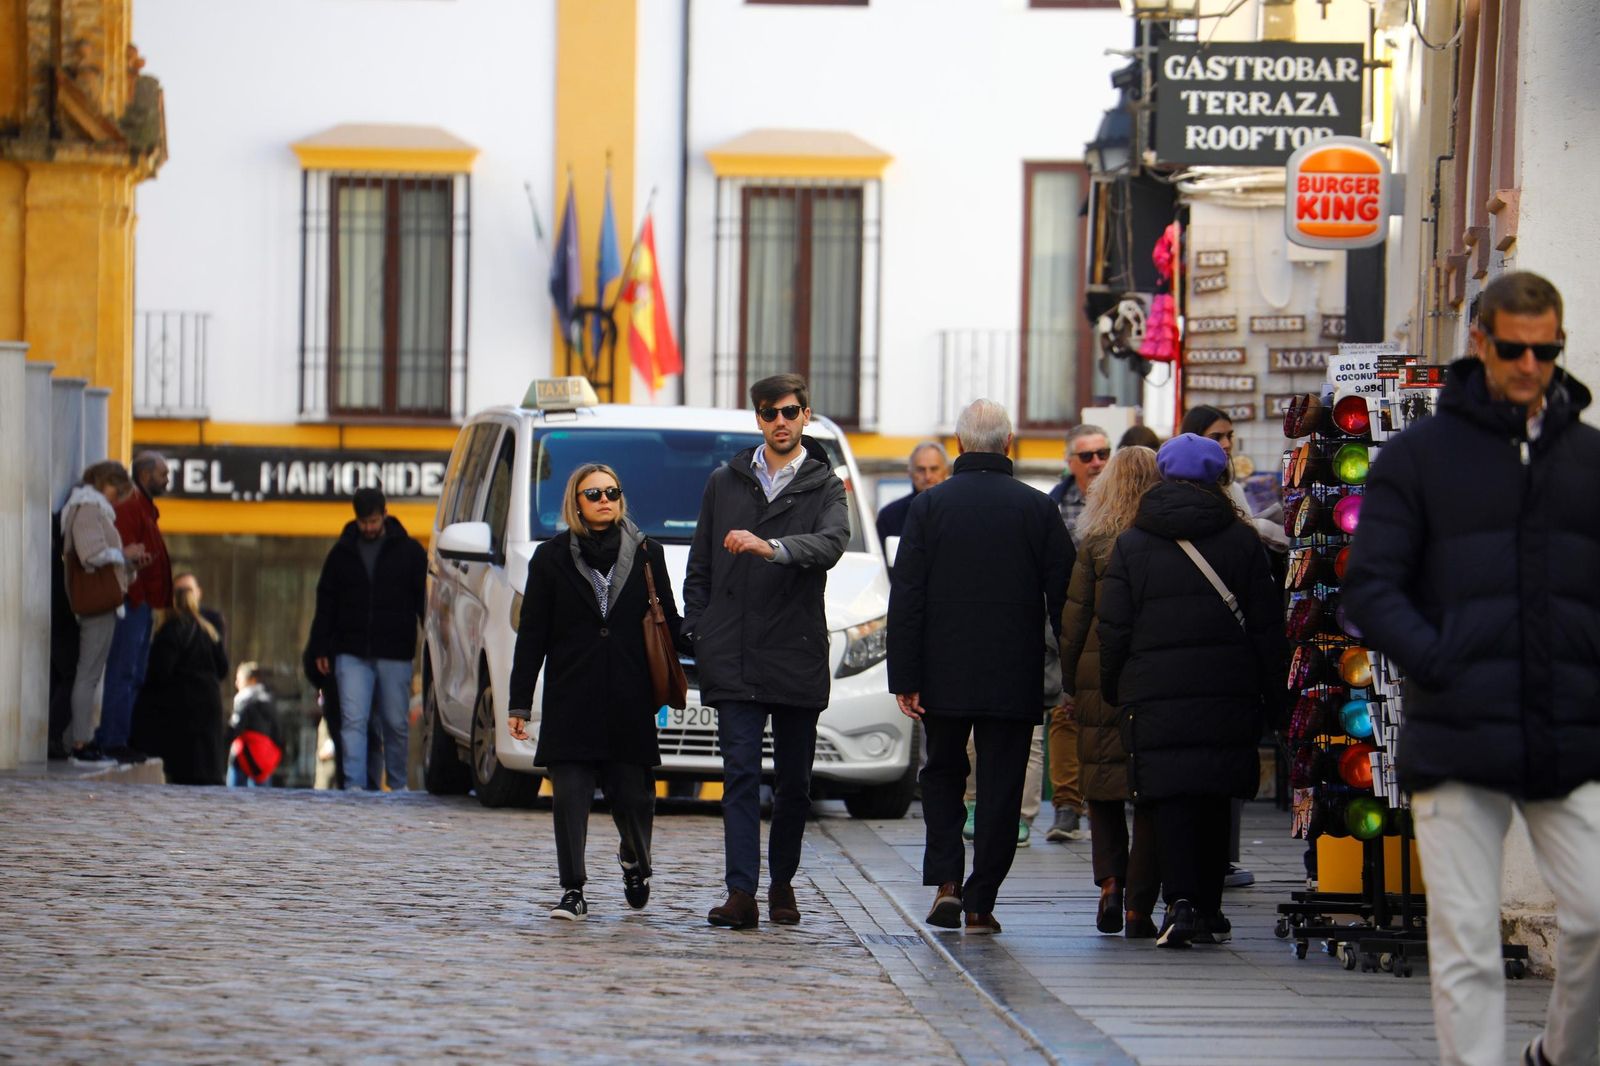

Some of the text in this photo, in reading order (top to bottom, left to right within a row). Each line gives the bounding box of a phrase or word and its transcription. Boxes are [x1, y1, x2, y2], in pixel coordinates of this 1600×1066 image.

[1163, 55, 1360, 81] GASTROBAR
[1180, 91, 1339, 116] TERRAZA
[1297, 176, 1380, 195] BURGER
[1297, 197, 1379, 221] KING
[538, 382, 569, 397] TAXI
[165, 458, 234, 493] TEL
